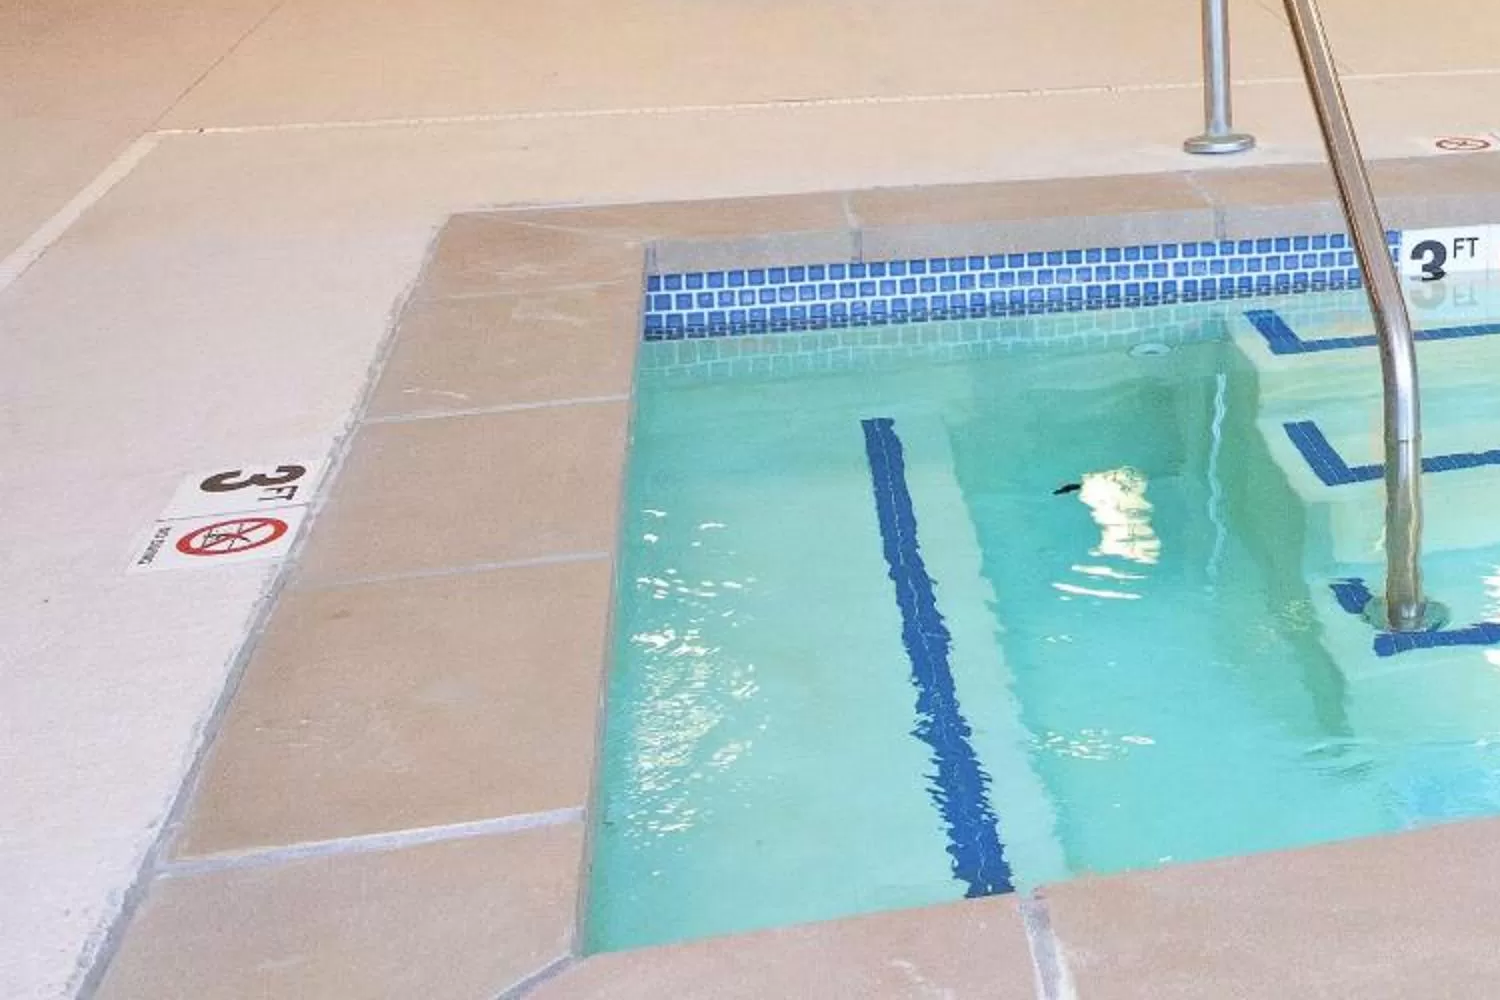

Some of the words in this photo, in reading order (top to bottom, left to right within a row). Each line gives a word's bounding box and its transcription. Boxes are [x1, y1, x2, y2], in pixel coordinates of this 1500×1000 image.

[1410, 239, 1447, 281] 3
[1453, 237, 1479, 258] FT
[200, 465, 306, 492] 3
